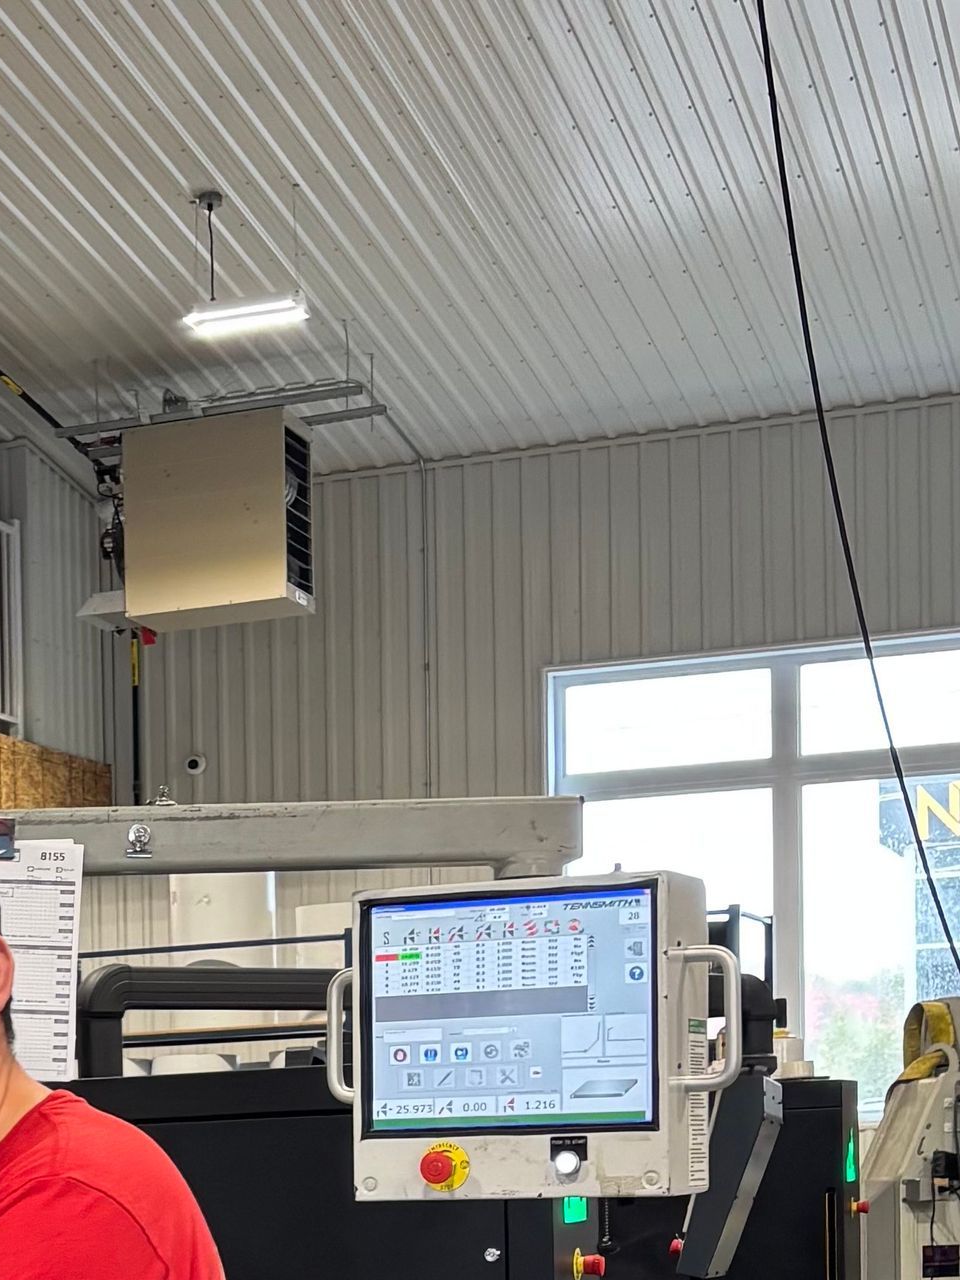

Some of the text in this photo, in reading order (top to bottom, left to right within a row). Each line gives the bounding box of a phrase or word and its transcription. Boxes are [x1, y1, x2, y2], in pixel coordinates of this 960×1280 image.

[40, 851, 66, 862] 8155
[562, 898, 633, 911] TENNSMITH
[628, 911, 640, 921] 28
[396, 1104, 433, 1115] 25.973
[462, 1101, 487, 1112] 0.00
[525, 1099, 556, 1110] 1.216
